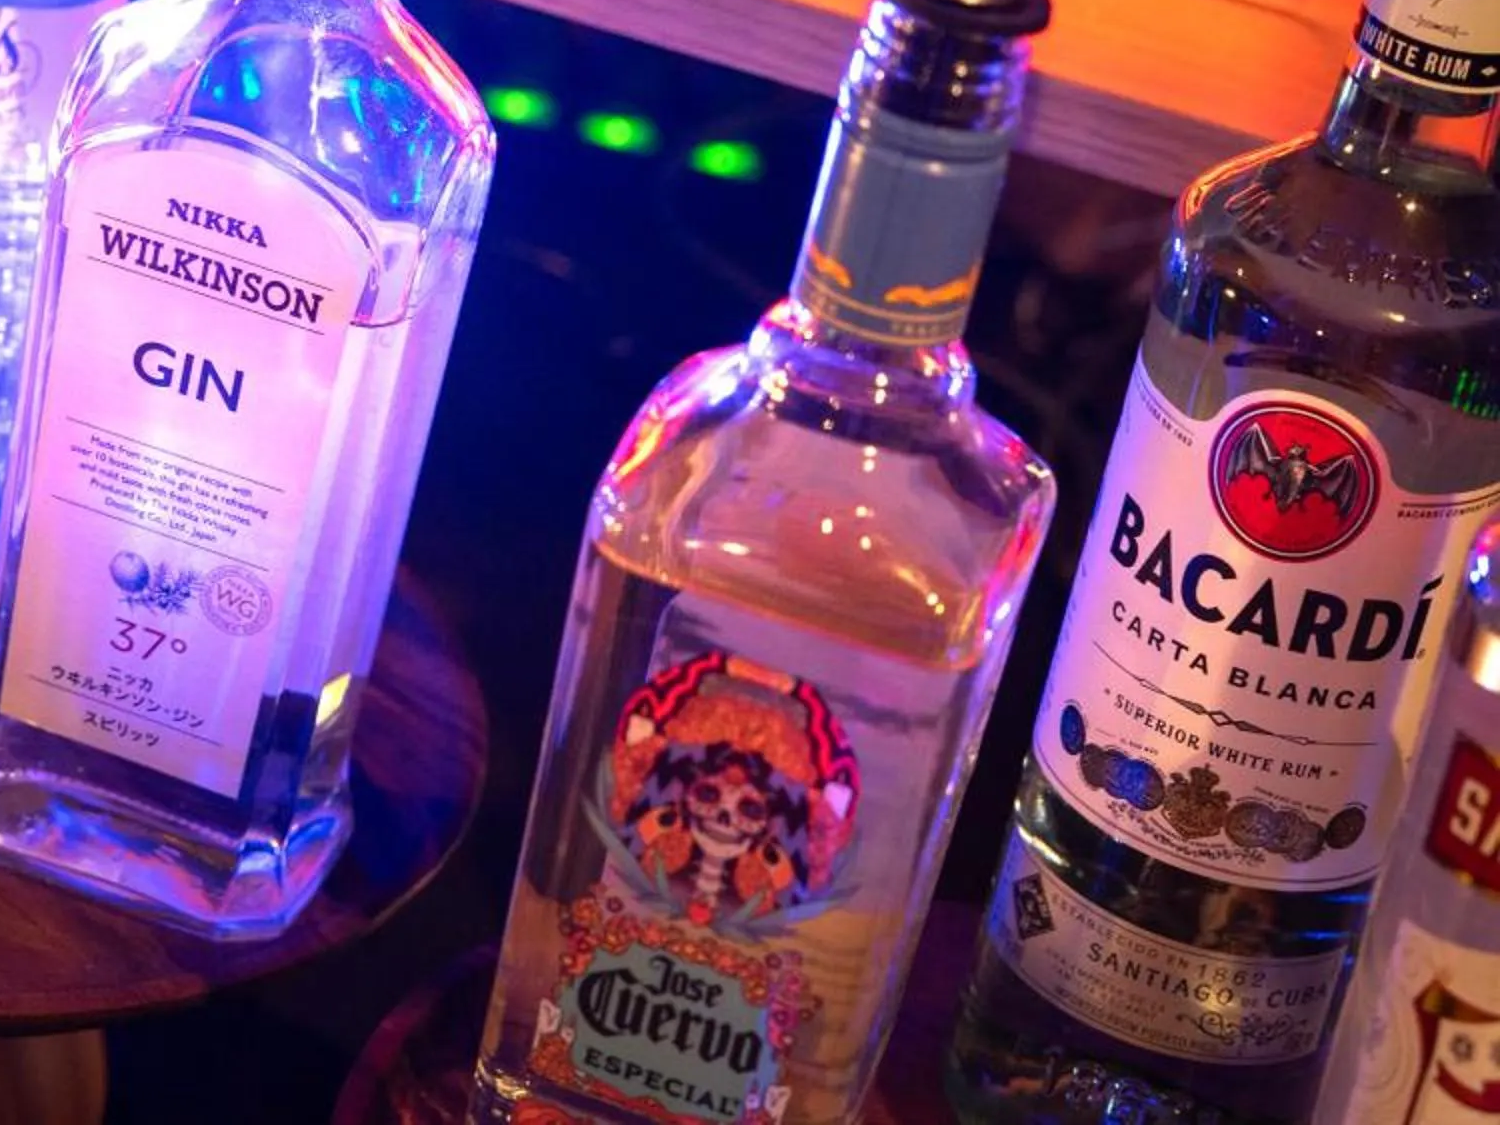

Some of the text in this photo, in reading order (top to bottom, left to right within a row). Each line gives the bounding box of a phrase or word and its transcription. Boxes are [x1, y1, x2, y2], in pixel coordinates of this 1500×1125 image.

[1360, 24, 1417, 68] WHITE
[1424, 51, 1471, 79] RUM
[166, 198, 268, 248] NIKKA
[100, 223, 324, 324] WILKINSON
[133, 341, 244, 412] GIN
[217, 583, 258, 620] WG
[1109, 492, 1446, 663] BACARDÍ
[106, 665, 154, 693] ニッカ
[1112, 600, 1378, 710] CARTA BLANCA
[83, 710, 160, 747] スピリッツ
[1113, 693, 1201, 751] SUPERIOR
[1208, 742, 1272, 772] WHITE
[1281, 757, 1323, 780] RUM
[644, 954, 723, 1008] Jose
[1087, 942, 1234, 1006] SANTIAGO
[1266, 980, 1328, 1009] CUBA
[1196, 960, 1266, 990] 1862
[577, 968, 763, 1075] Cuervo
[583, 1046, 736, 1116] ESPECIAL
